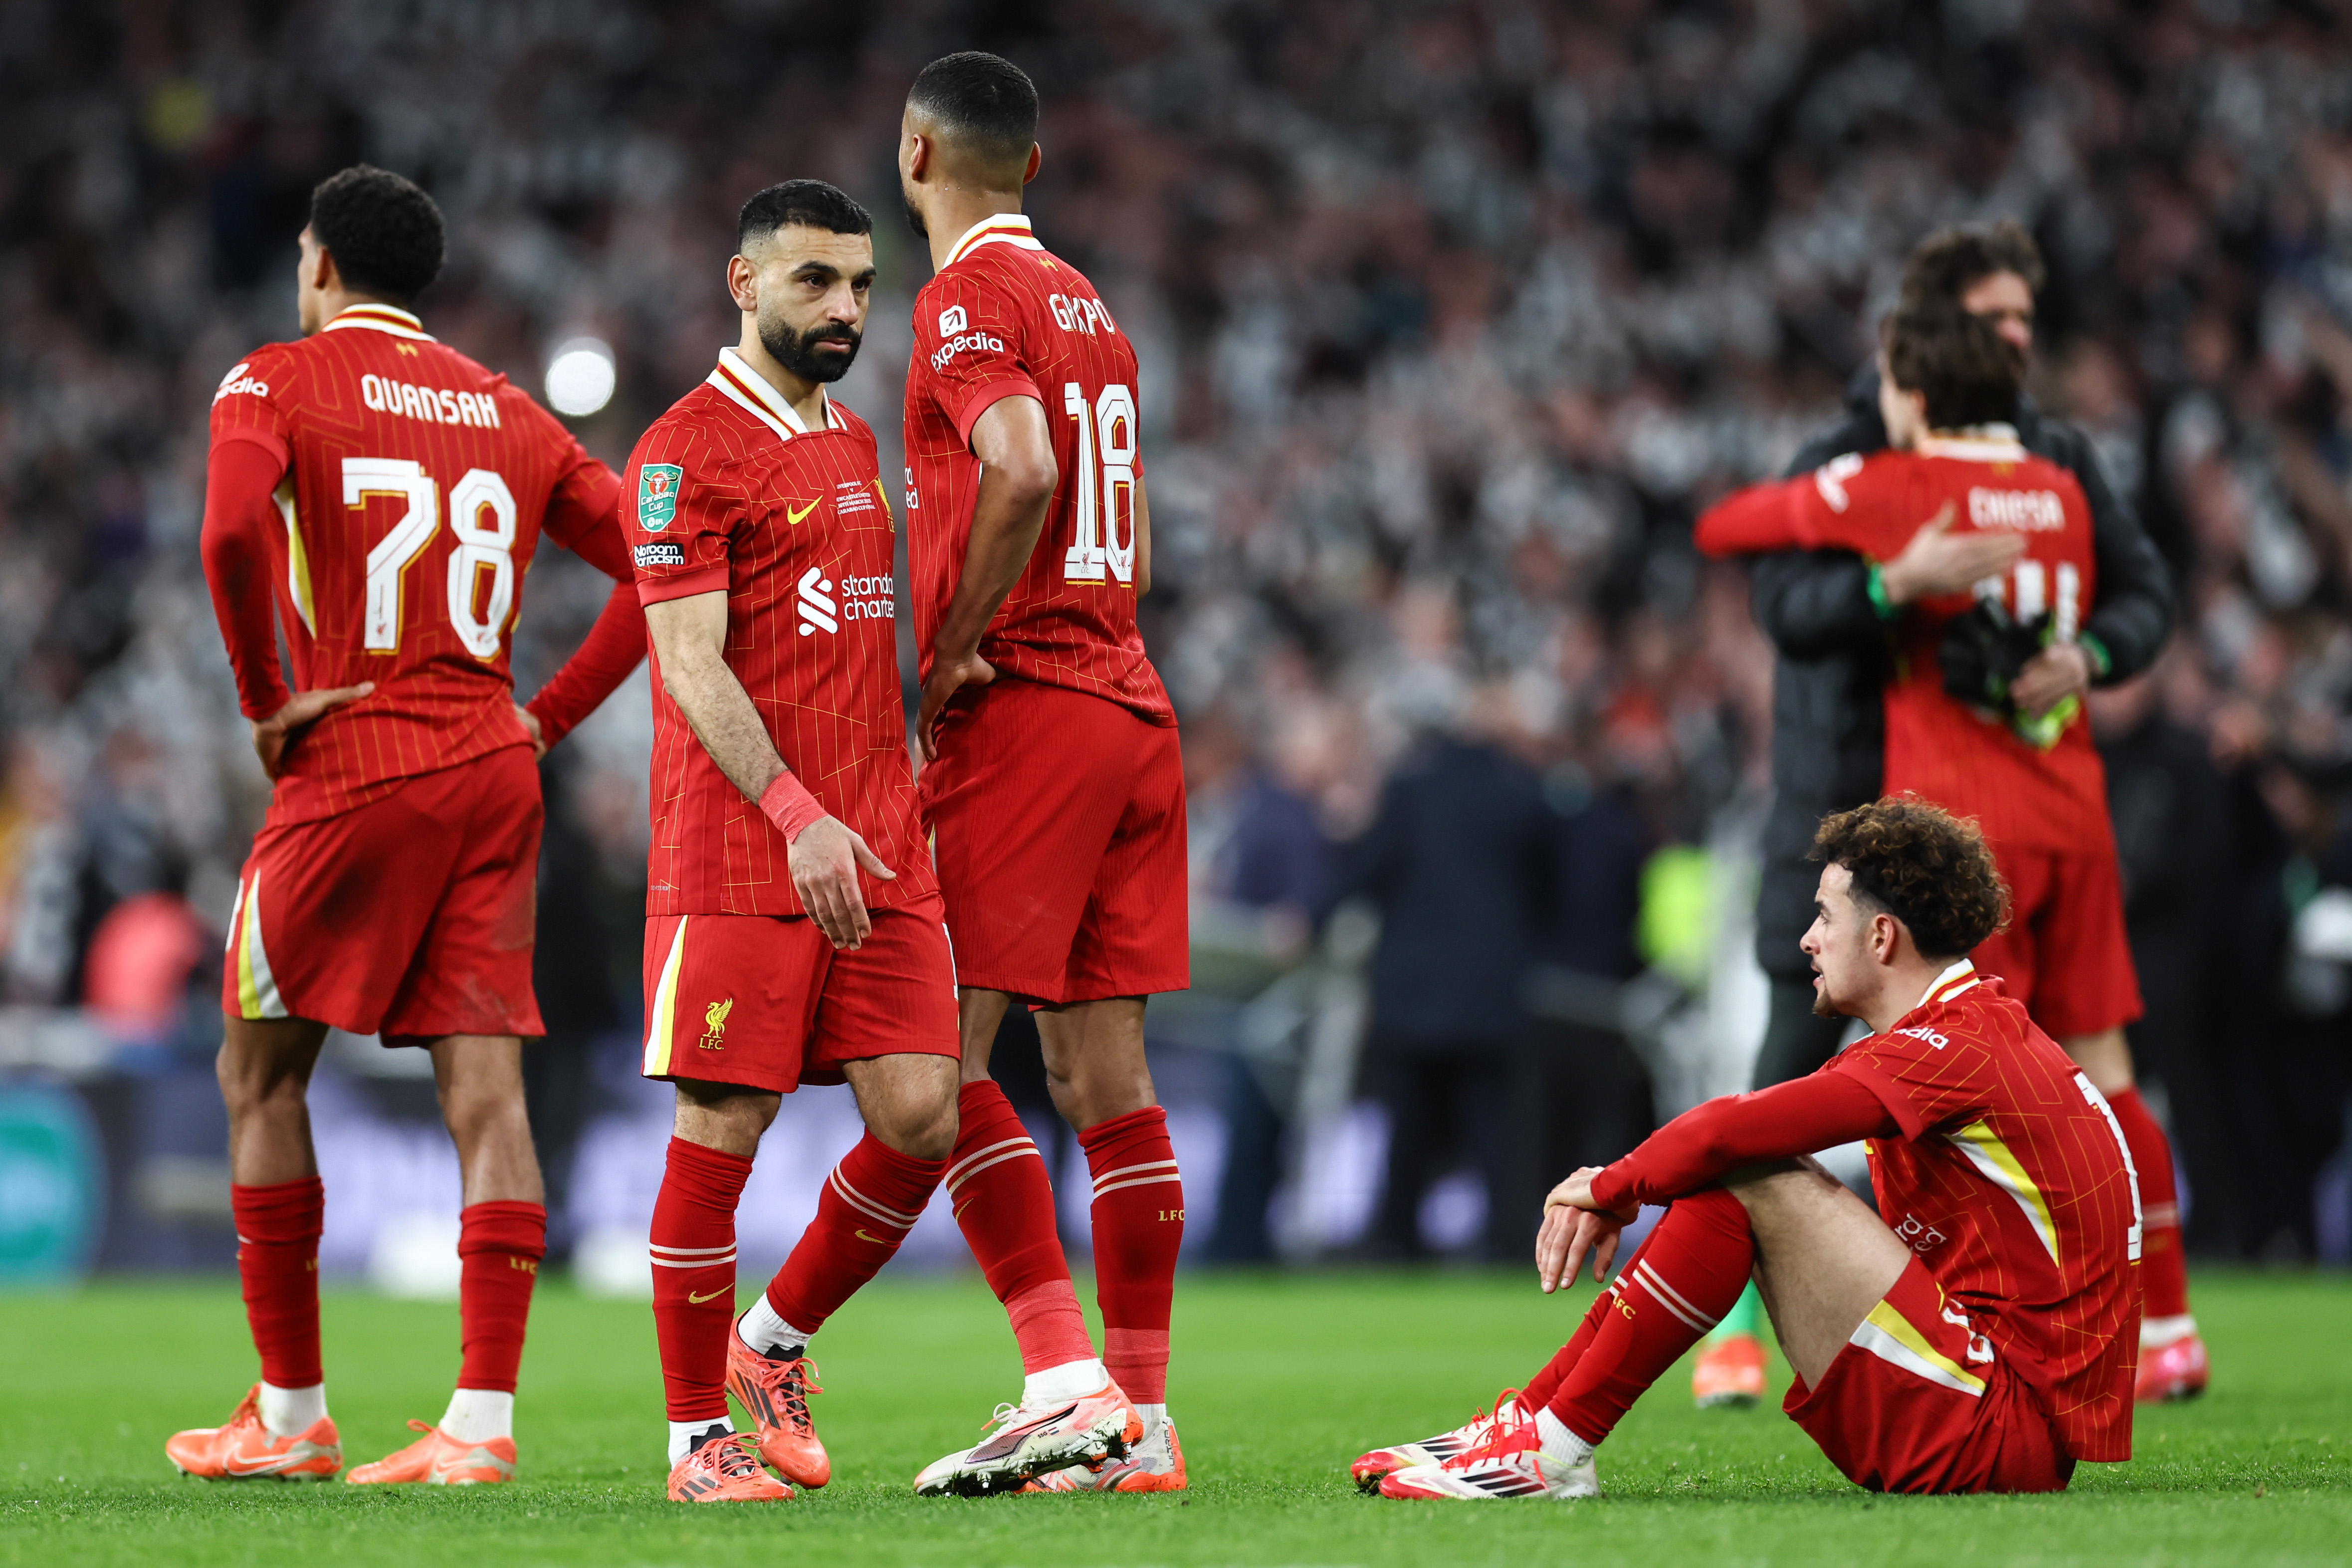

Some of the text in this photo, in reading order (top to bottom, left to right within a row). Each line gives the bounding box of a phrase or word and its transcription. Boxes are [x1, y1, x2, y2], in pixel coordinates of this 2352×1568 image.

[1049, 293, 1115, 336] GAKPO
[361, 374, 500, 429] QUANSAH
[1064, 382, 1136, 586] 18
[641, 491, 674, 505] Carabao
[836, 493, 858, 502] EWCASTLE
[649, 501, 663, 512] Cup
[634, 545, 678, 558] No room
[341, 457, 517, 661] 78
[648, 554, 683, 565] racism
[699, 1038, 724, 1050] L.F.C.
[1158, 1210, 1185, 1221] LFC
